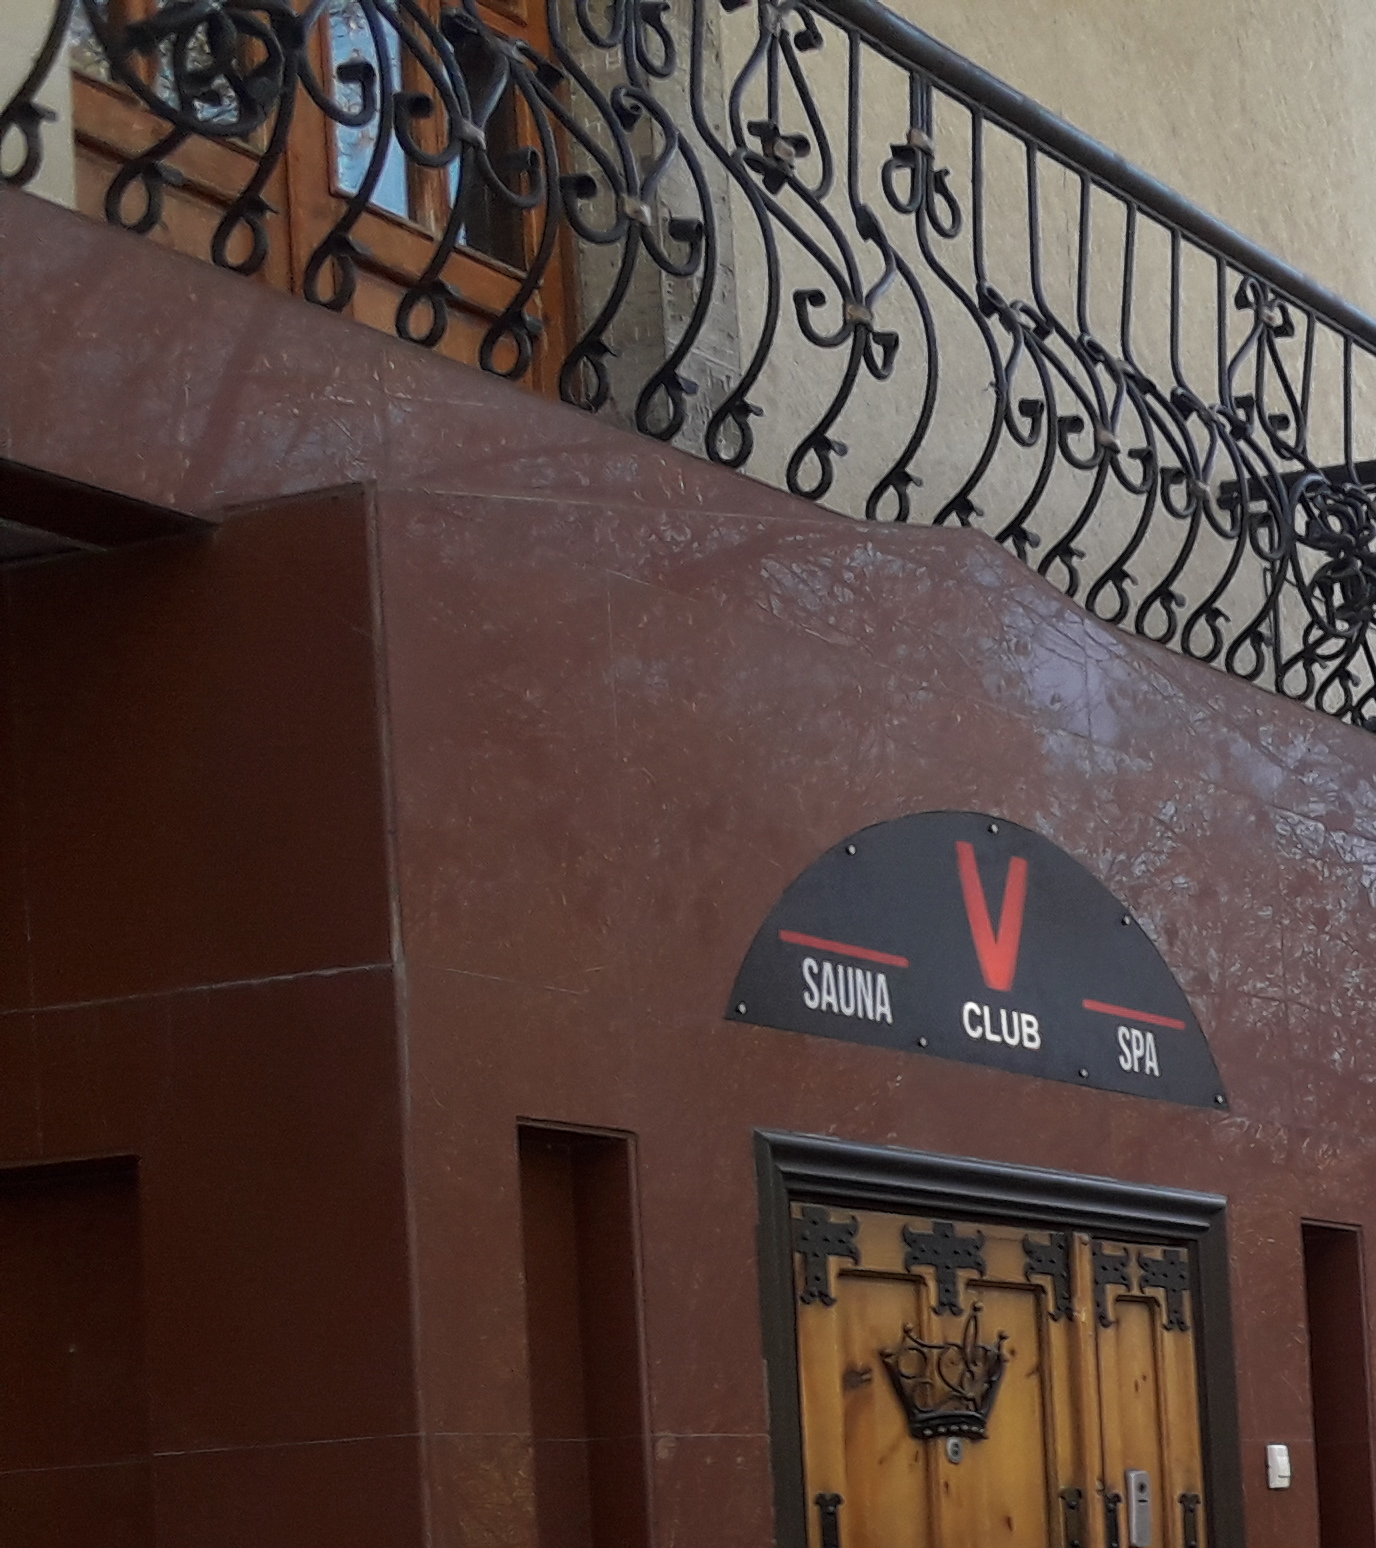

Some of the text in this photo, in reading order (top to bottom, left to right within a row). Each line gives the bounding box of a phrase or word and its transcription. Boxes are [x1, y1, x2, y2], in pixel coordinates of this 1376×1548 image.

[956, 841, 1028, 991] V
[802, 957, 893, 1024] SAUNA
[963, 1002, 1041, 1049] CLUB
[1117, 1026, 1161, 1077] SPA
